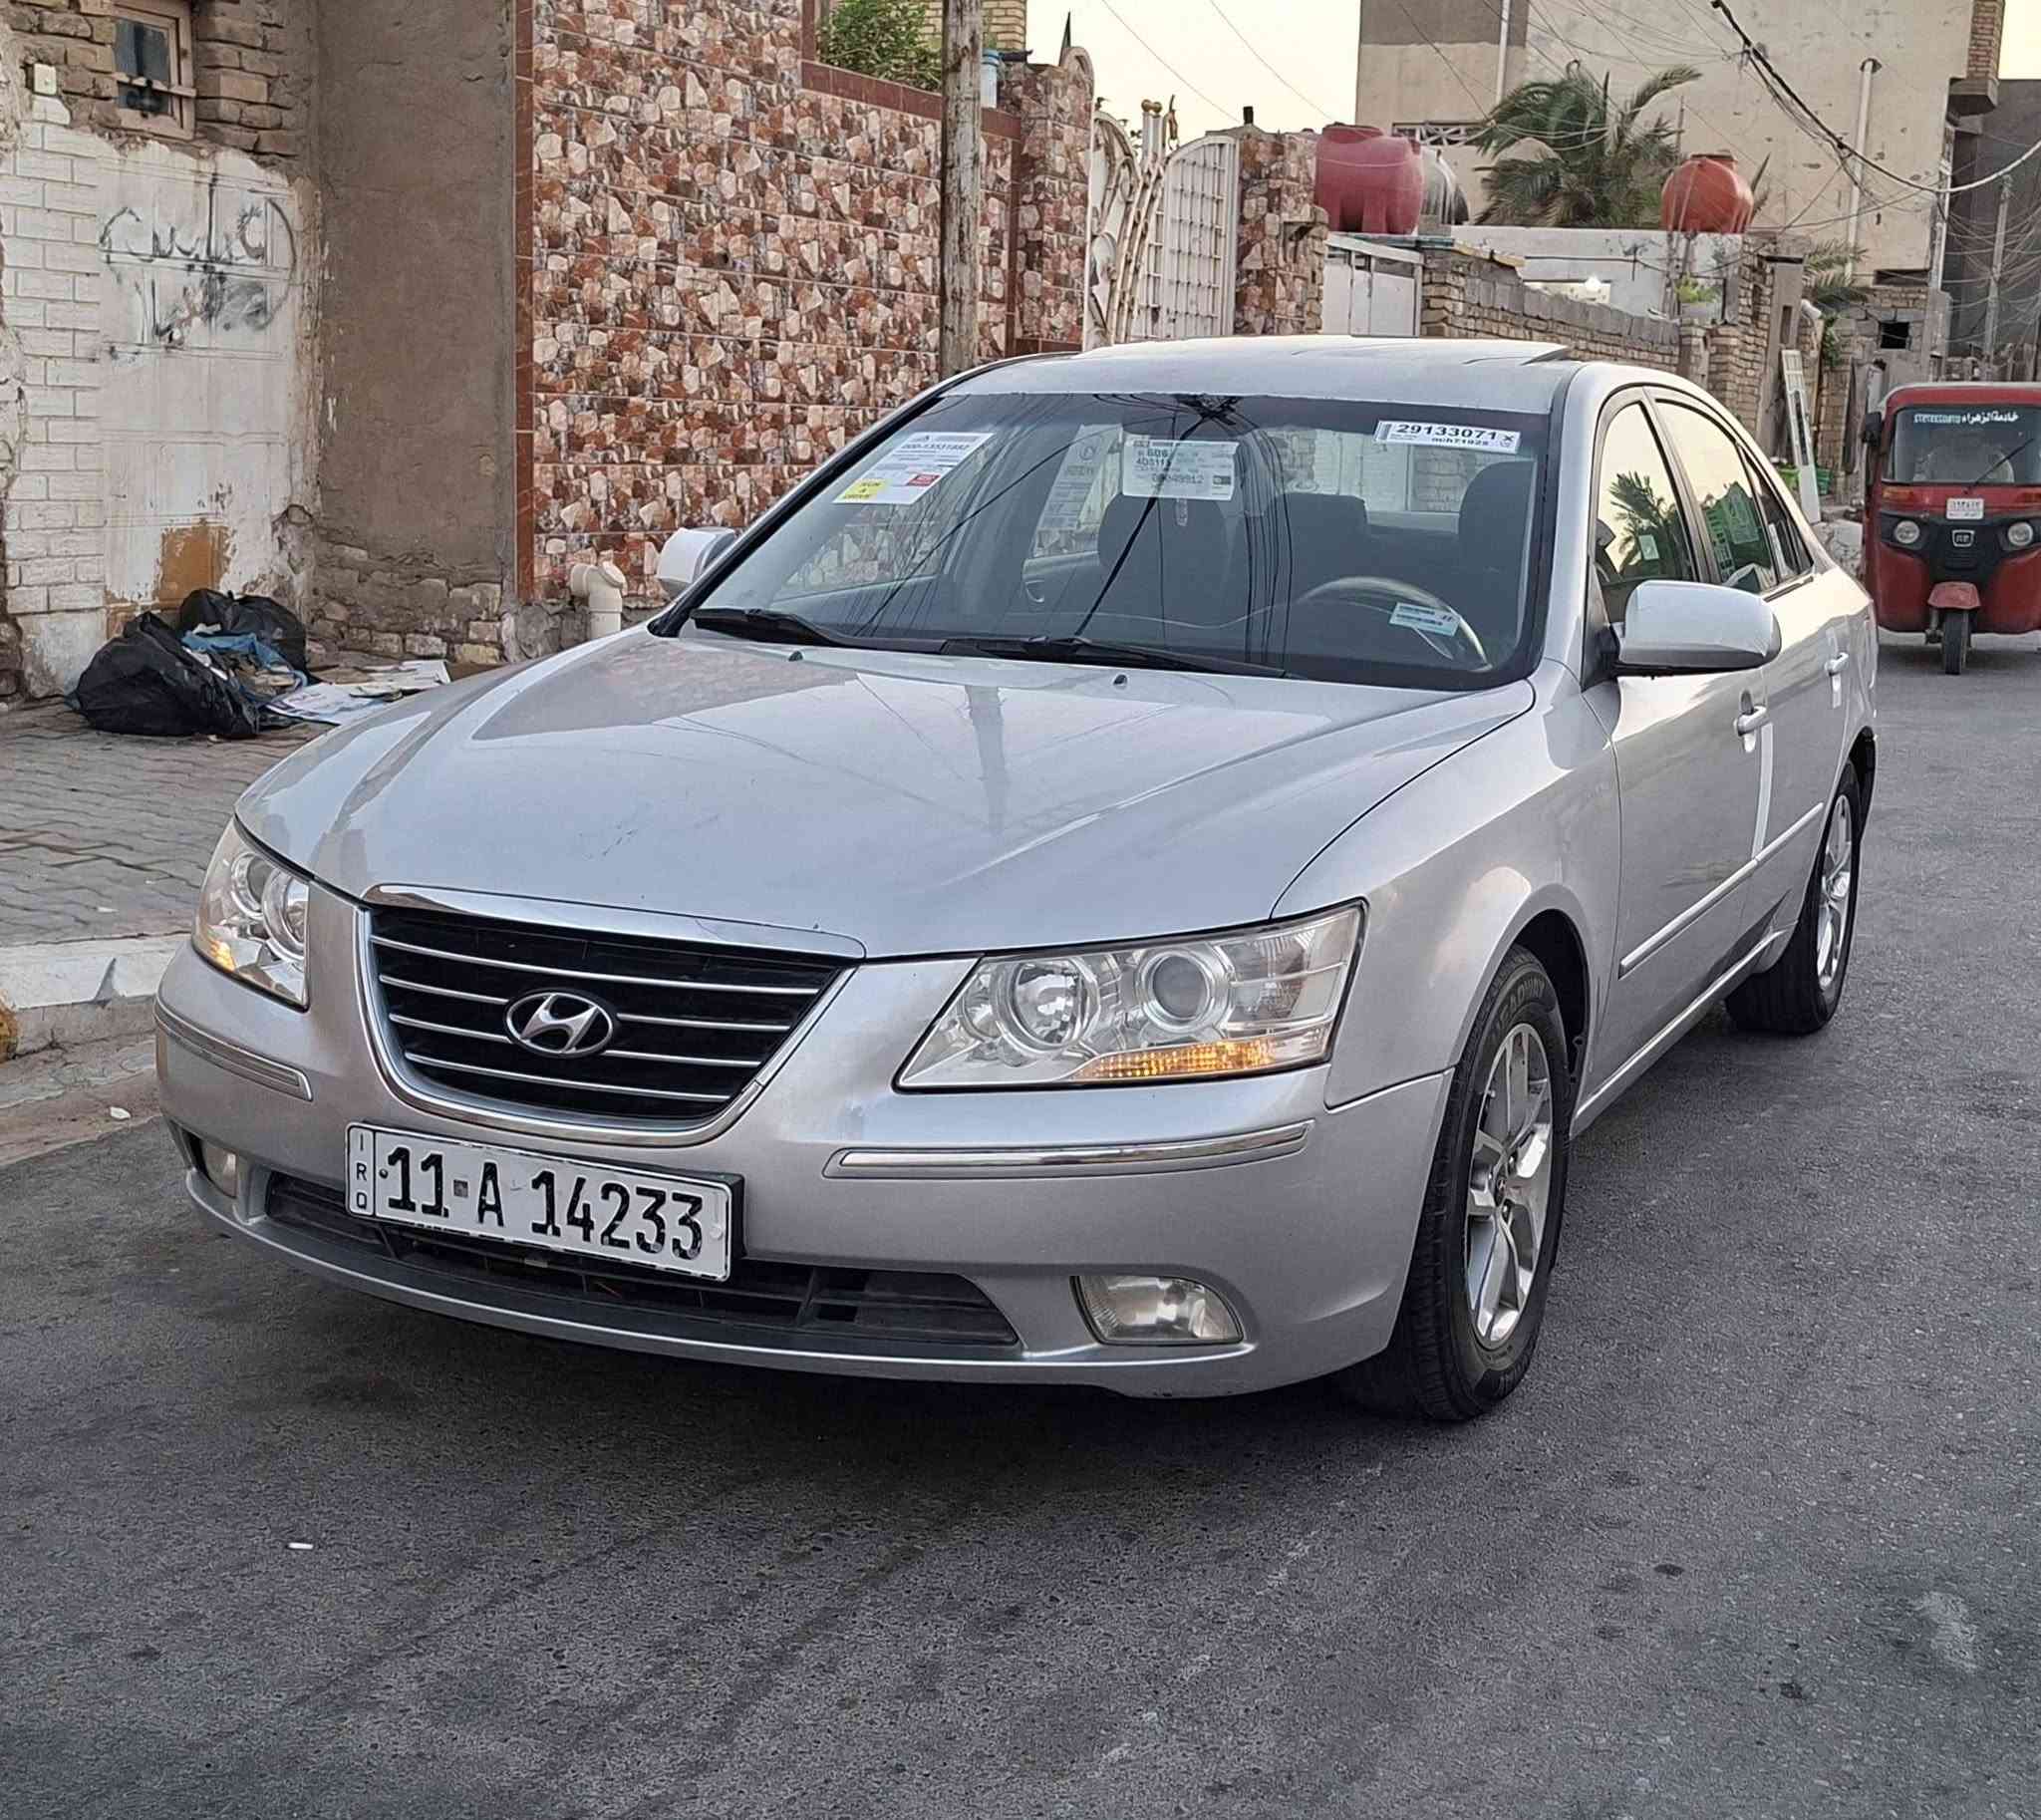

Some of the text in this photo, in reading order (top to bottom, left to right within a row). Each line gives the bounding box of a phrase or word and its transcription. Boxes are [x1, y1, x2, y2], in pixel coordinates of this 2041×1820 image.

[1396, 424, 1497, 441] 29133071
[356, 1132, 368, 1210] IRQ
[388, 1146, 703, 1260] 11 A 14233
